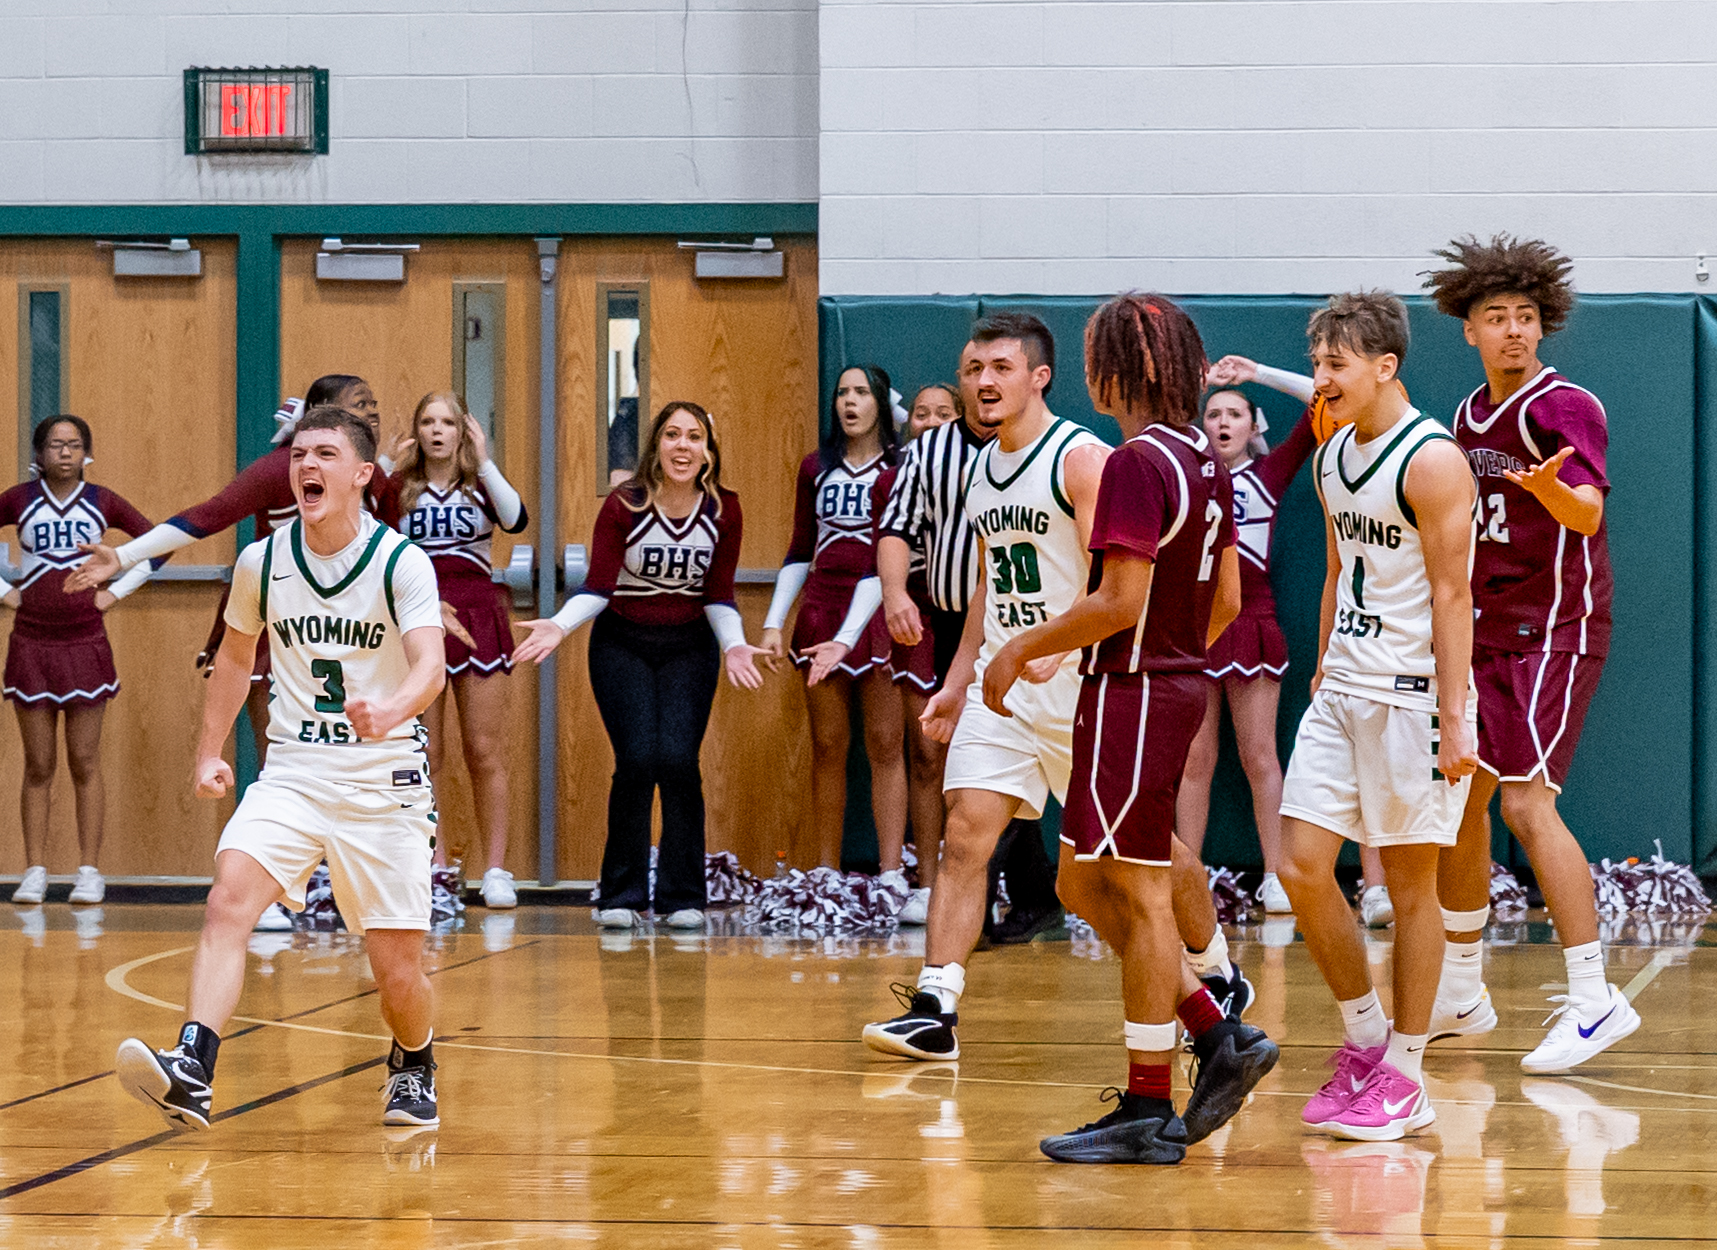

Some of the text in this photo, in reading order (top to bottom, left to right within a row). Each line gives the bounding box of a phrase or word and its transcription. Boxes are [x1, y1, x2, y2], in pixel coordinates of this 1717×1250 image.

[221, 85, 291, 136] EXIT
[33, 520, 90, 553] BHS
[408, 505, 475, 540] BHS
[1332, 511, 1402, 550] YOMING
[639, 546, 711, 580] BHS
[989, 541, 1042, 595] 30
[1351, 555, 1366, 611] 1
[995, 601, 1048, 628] EAST
[272, 615, 386, 650] WYOMING
[311, 658, 346, 714] 3
[298, 719, 362, 744] EAS
